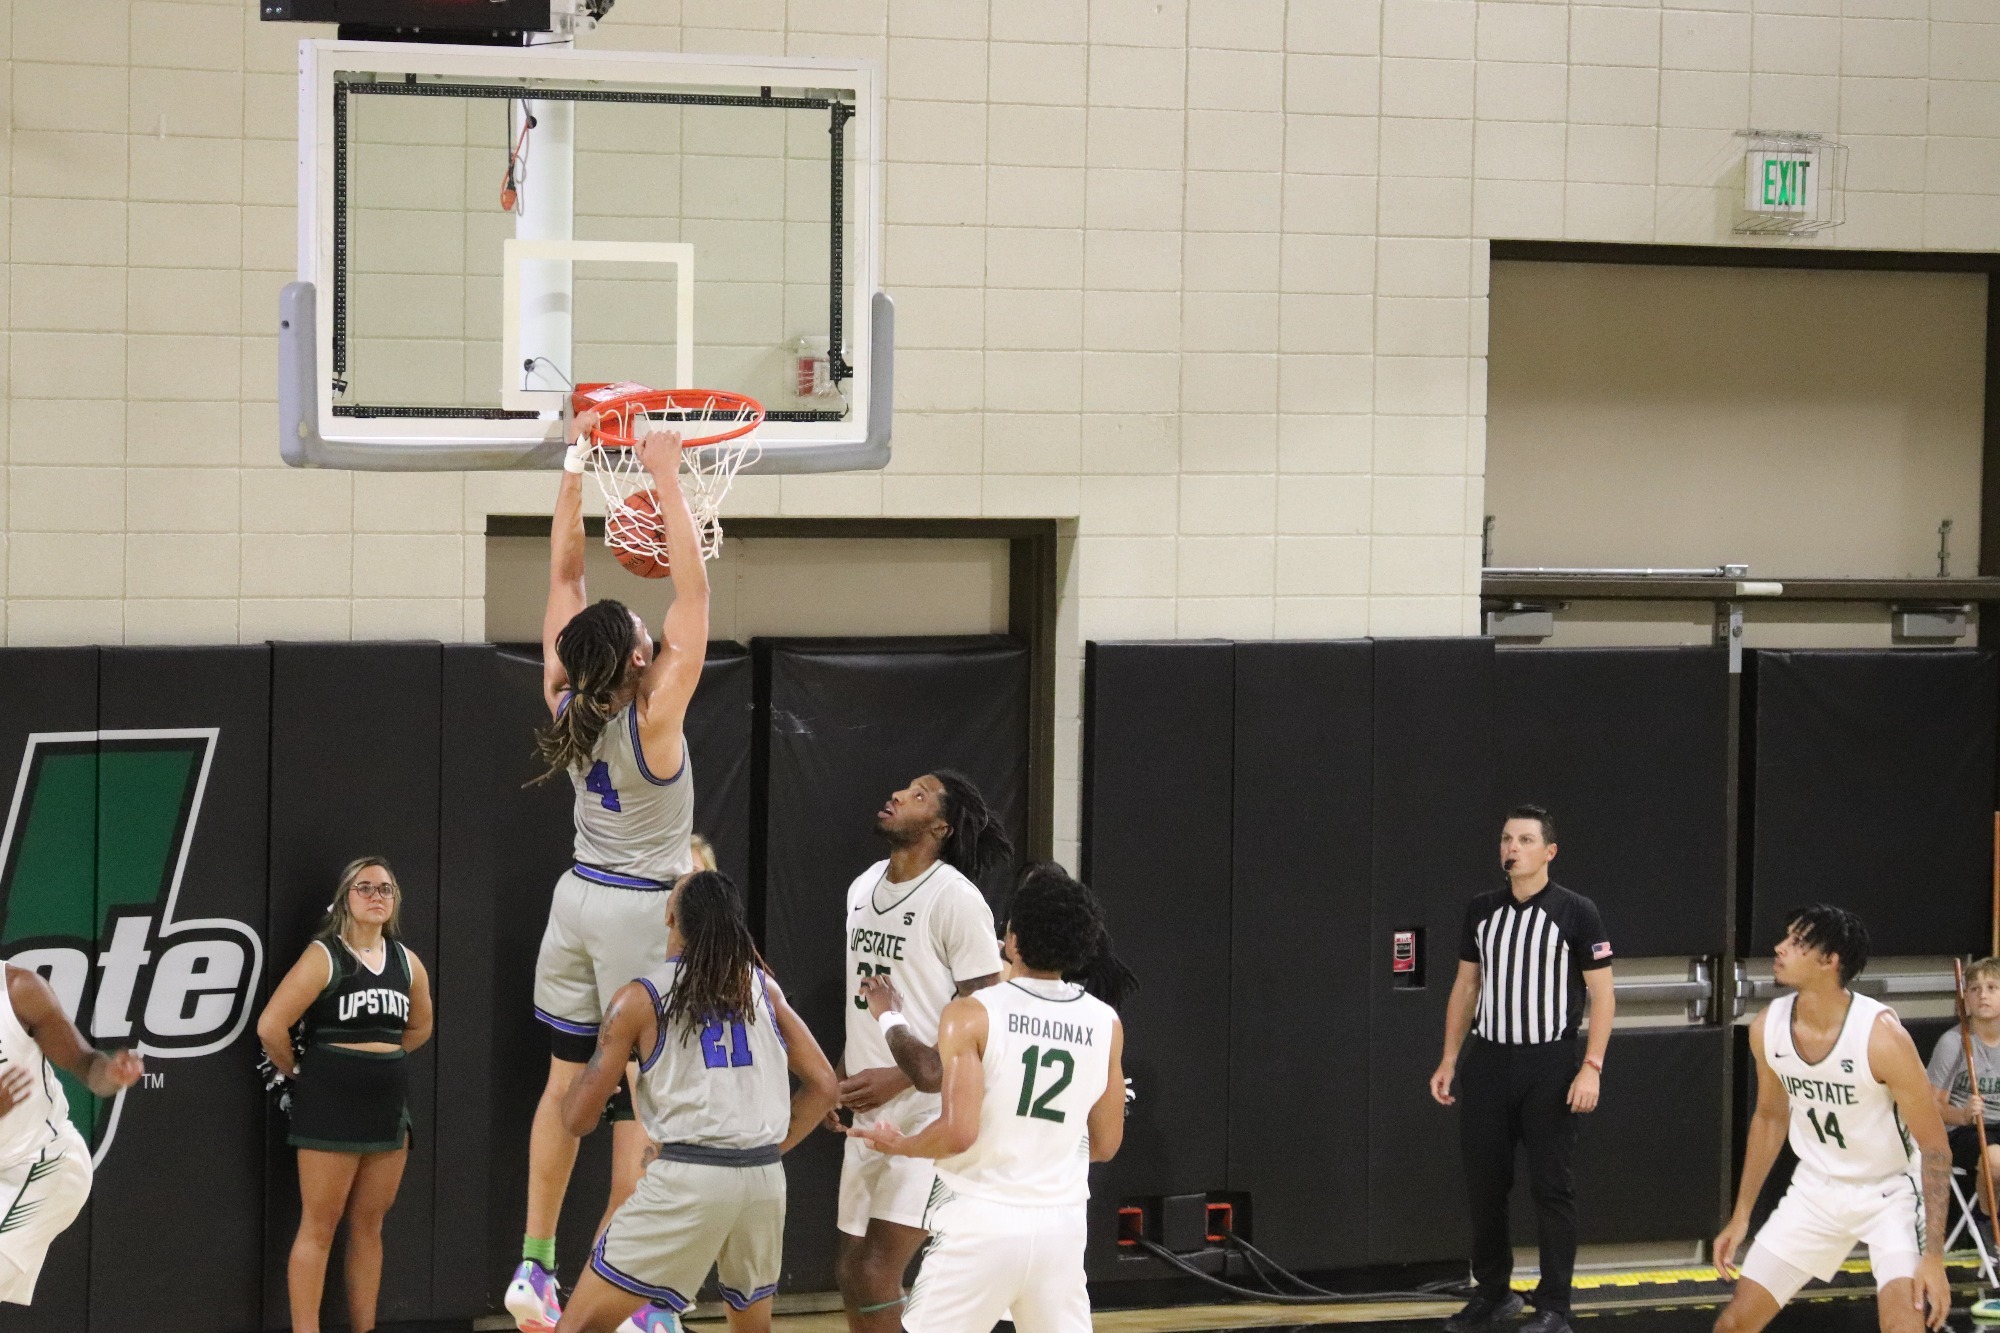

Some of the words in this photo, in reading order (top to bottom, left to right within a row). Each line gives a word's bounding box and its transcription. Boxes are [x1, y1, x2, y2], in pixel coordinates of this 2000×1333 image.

[1763, 160, 1810, 206] EXIT
[585, 759, 621, 812] 4
[851, 928, 906, 961] UPSTATE
[338, 988, 410, 1023] UPSTATE
[700, 1012, 753, 1069] 21
[1008, 1013, 1093, 1047] BROADNAX
[143, 1074, 164, 1089] TM
[1016, 1045, 1075, 1124] 12
[1781, 1074, 1859, 1106] UPSTATE
[1807, 1107, 1847, 1149] 14
